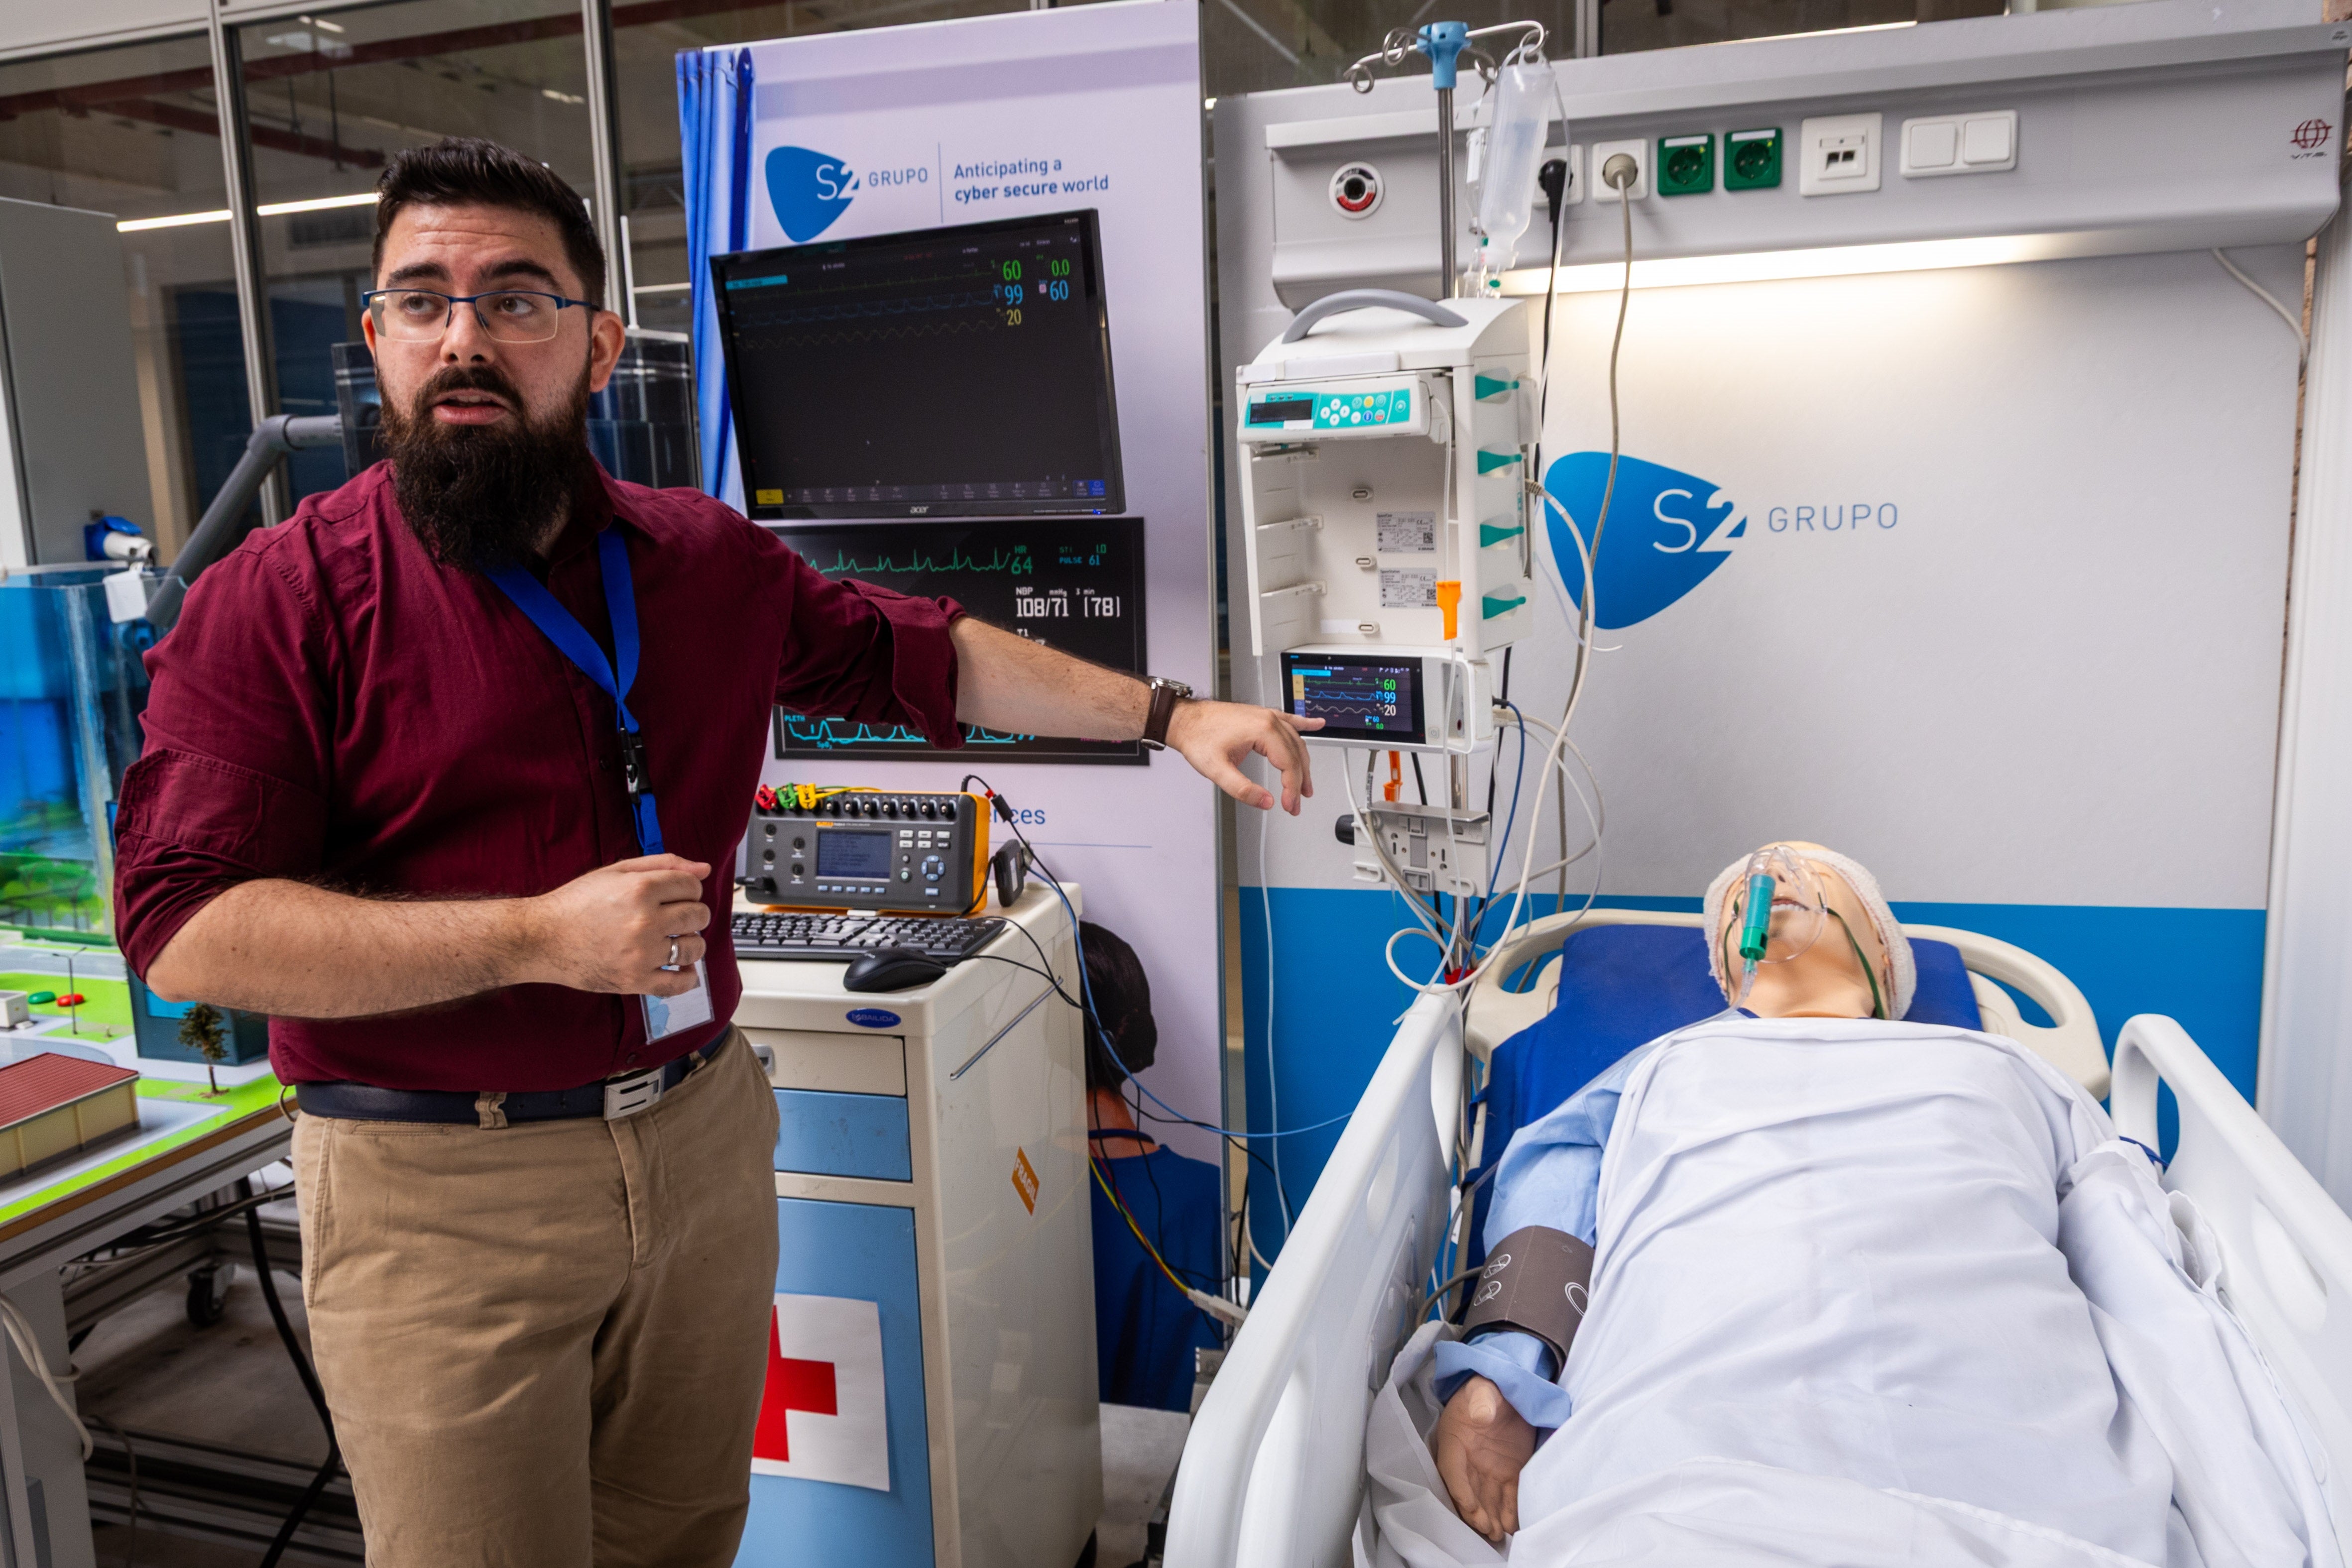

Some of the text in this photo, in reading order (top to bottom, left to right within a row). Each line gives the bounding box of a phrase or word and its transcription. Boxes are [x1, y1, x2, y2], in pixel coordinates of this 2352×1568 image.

[953, 158, 1062, 179] Anticipating a
[816, 163, 928, 201] S2 GRUPO
[954, 174, 1109, 205] cyber secure world
[1003, 258, 1070, 281] 60 0.0
[1004, 279, 1069, 306] 99 60
[1006, 308, 1022, 326] 20
[1652, 487, 1898, 554] S2 GRUPO
[1014, 545, 1027, 554] HR
[1011, 556, 1033, 575] 64
[1088, 555, 1100, 566] 61
[1016, 586, 1034, 595] NBP
[1016, 597, 1069, 617] 108/71
[1384, 678, 1396, 691] 60
[1384, 691, 1397, 704] 99
[1384, 704, 1397, 716] 20
